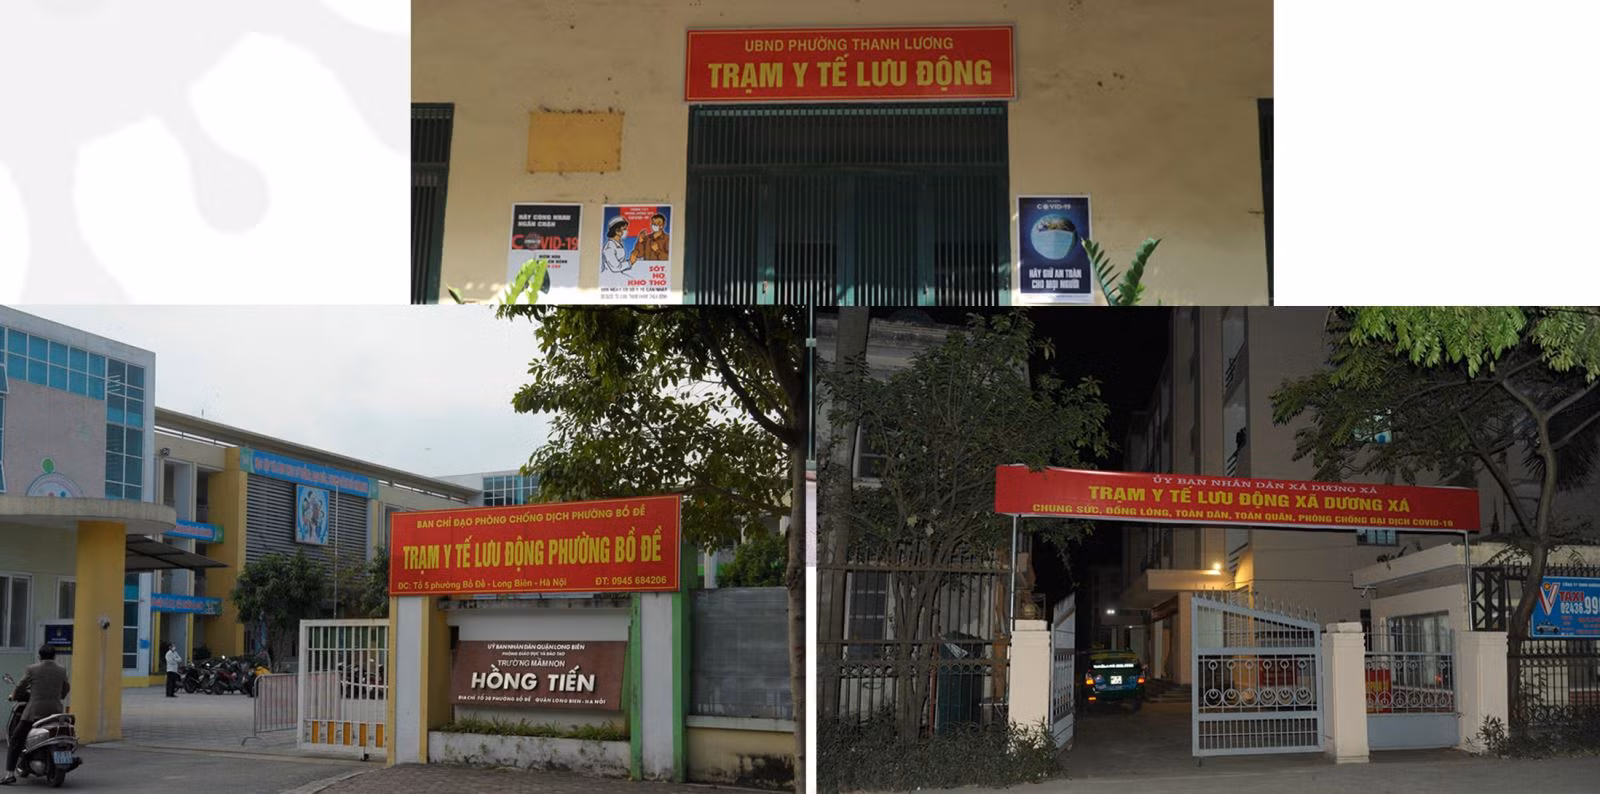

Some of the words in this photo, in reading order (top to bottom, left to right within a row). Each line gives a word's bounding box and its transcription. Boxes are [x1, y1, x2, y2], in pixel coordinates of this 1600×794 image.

[745, 39, 784, 52] UBND
[788, 36, 847, 52] PHƯỜNG
[852, 37, 900, 51] THANH
[904, 36, 954, 50] LƯƠNG
[708, 62, 783, 94] TRẠM
[792, 62, 809, 88] Y
[816, 53, 850, 87] TẾ
[857, 58, 907, 87] LƯU
[916, 55, 992, 91] ĐỘNG
[1178, 478, 1207, 486] BAN
[1211, 479, 1251, 488] NHÂN
[1256, 481, 1285, 490] DÂN
[1311, 484, 1356, 493] DƯƠNG
[1088, 485, 1145, 503] TRẠM
[1152, 488, 1164, 502] Y
[1170, 486, 1193, 503] TẾ
[1198, 490, 1233, 505] LƯU
[1239, 490, 1290, 509] ĐỘNG
[1295, 493, 1319, 508] XÃ
[1324, 496, 1382, 511] DƯƠNG
[1388, 497, 1410, 513] XÁ
[416, 520, 434, 529] BAN
[436, 516, 452, 528] CHỈ
[453, 517, 473, 529] ĐẠO
[475, 514, 507, 526] PHÒNG
[509, 511, 544, 523] CHỐNG
[546, 512, 569, 523] DỊCH
[572, 507, 613, 520] PHƯỜNG
[616, 504, 630, 518] BỒ
[633, 503, 646, 516] ĐỀ
[1033, 503, 1073, 513] CHUNG
[1106, 505, 1137, 515] ĐỒNG
[1175, 509, 1204, 518] TOÀN
[1235, 511, 1262, 520] TOÀN
[1298, 513, 1333, 523] PHÒNG
[1335, 515, 1367, 524] CHỐNG
[1370, 517, 1386, 526] ĐẠI
[1388, 517, 1410, 526] DỊCH
[1412, 518, 1454, 527] COVID-19
[403, 544, 440, 575] TRẠM
[444, 544, 452, 569] Y
[455, 535, 473, 568] TẾ
[475, 540, 501, 568] LƯU
[505, 535, 544, 572] ĐỘNG
[548, 531, 610, 565] PHƯỜNG
[615, 526, 636, 563] BỒ
[640, 524, 662, 562] ĐỀ
[430, 581, 461, 591] phường
[462, 580, 474, 588] Bồ
[492, 580, 512, 589] Long
[514, 579, 533, 587] Biên
[539, 578, 551, 587] Hà
[552, 578, 567, 588] Nội
[595, 577, 609, 586] ĐT:
[612, 576, 633, 585] 0945
[635, 575, 667, 585] 684206
[1560, 591, 1584, 602] TAXI
[1561, 596, 1600, 615] 02436.99
[536, 643, 554, 651] QUẬN
[498, 657, 530, 667] TRƯỜNG
[531, 657, 549, 667] MẦM
[549, 659, 565, 668] NON
[471, 664, 537, 690] HỒNG
[548, 665, 595, 692] TIẾN
